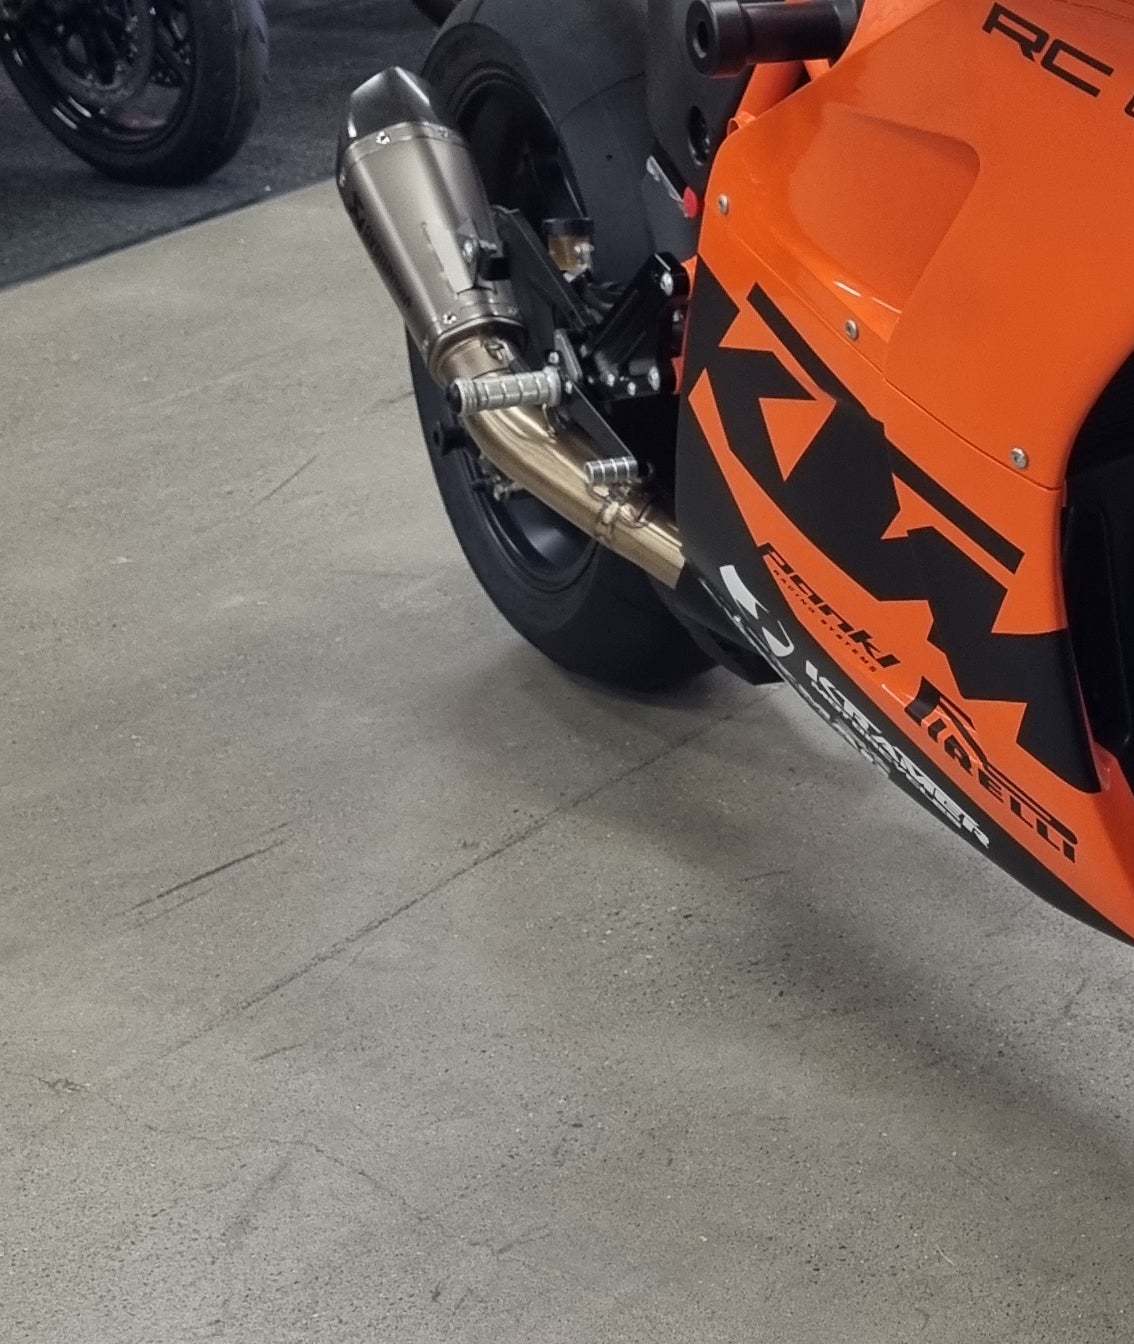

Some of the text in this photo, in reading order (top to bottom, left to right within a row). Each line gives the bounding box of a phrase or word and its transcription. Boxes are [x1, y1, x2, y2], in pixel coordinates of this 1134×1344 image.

[982, 2, 1114, 97] RC
[683, 253, 1102, 794] KTM
[757, 542, 901, 669] pankl
[773, 568, 816, 614] RACING
[819, 618, 878, 673] SYSTEMS
[904, 675, 1078, 864] PIRELLI
